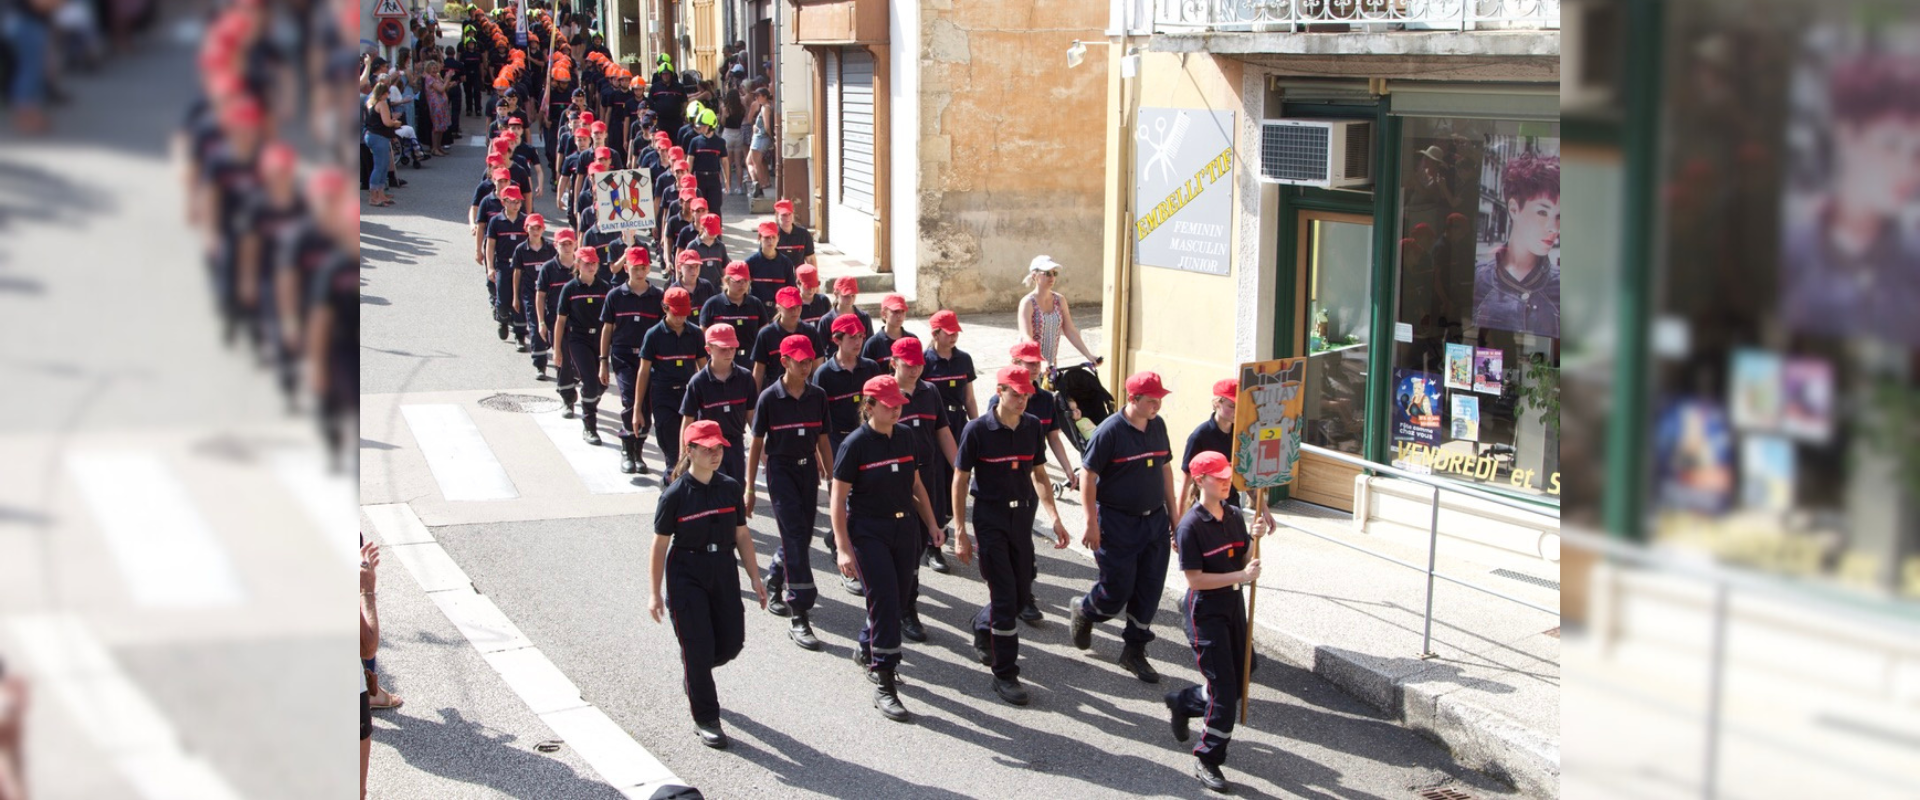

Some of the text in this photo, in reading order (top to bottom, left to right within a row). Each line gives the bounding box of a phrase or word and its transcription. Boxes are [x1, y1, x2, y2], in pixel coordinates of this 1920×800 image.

[1135, 147, 1232, 241] EMBELLI'TIF
[601, 219, 655, 231] SAINT MARCELLIN
[1173, 220, 1223, 238] FEMININ
[1169, 238, 1227, 256] MASCULIN
[1177, 256, 1218, 272] JUNIOR
[1254, 386, 1299, 404] VINAY
[1397, 440, 1499, 482] VENDREDI
[1510, 468, 1536, 489] et
